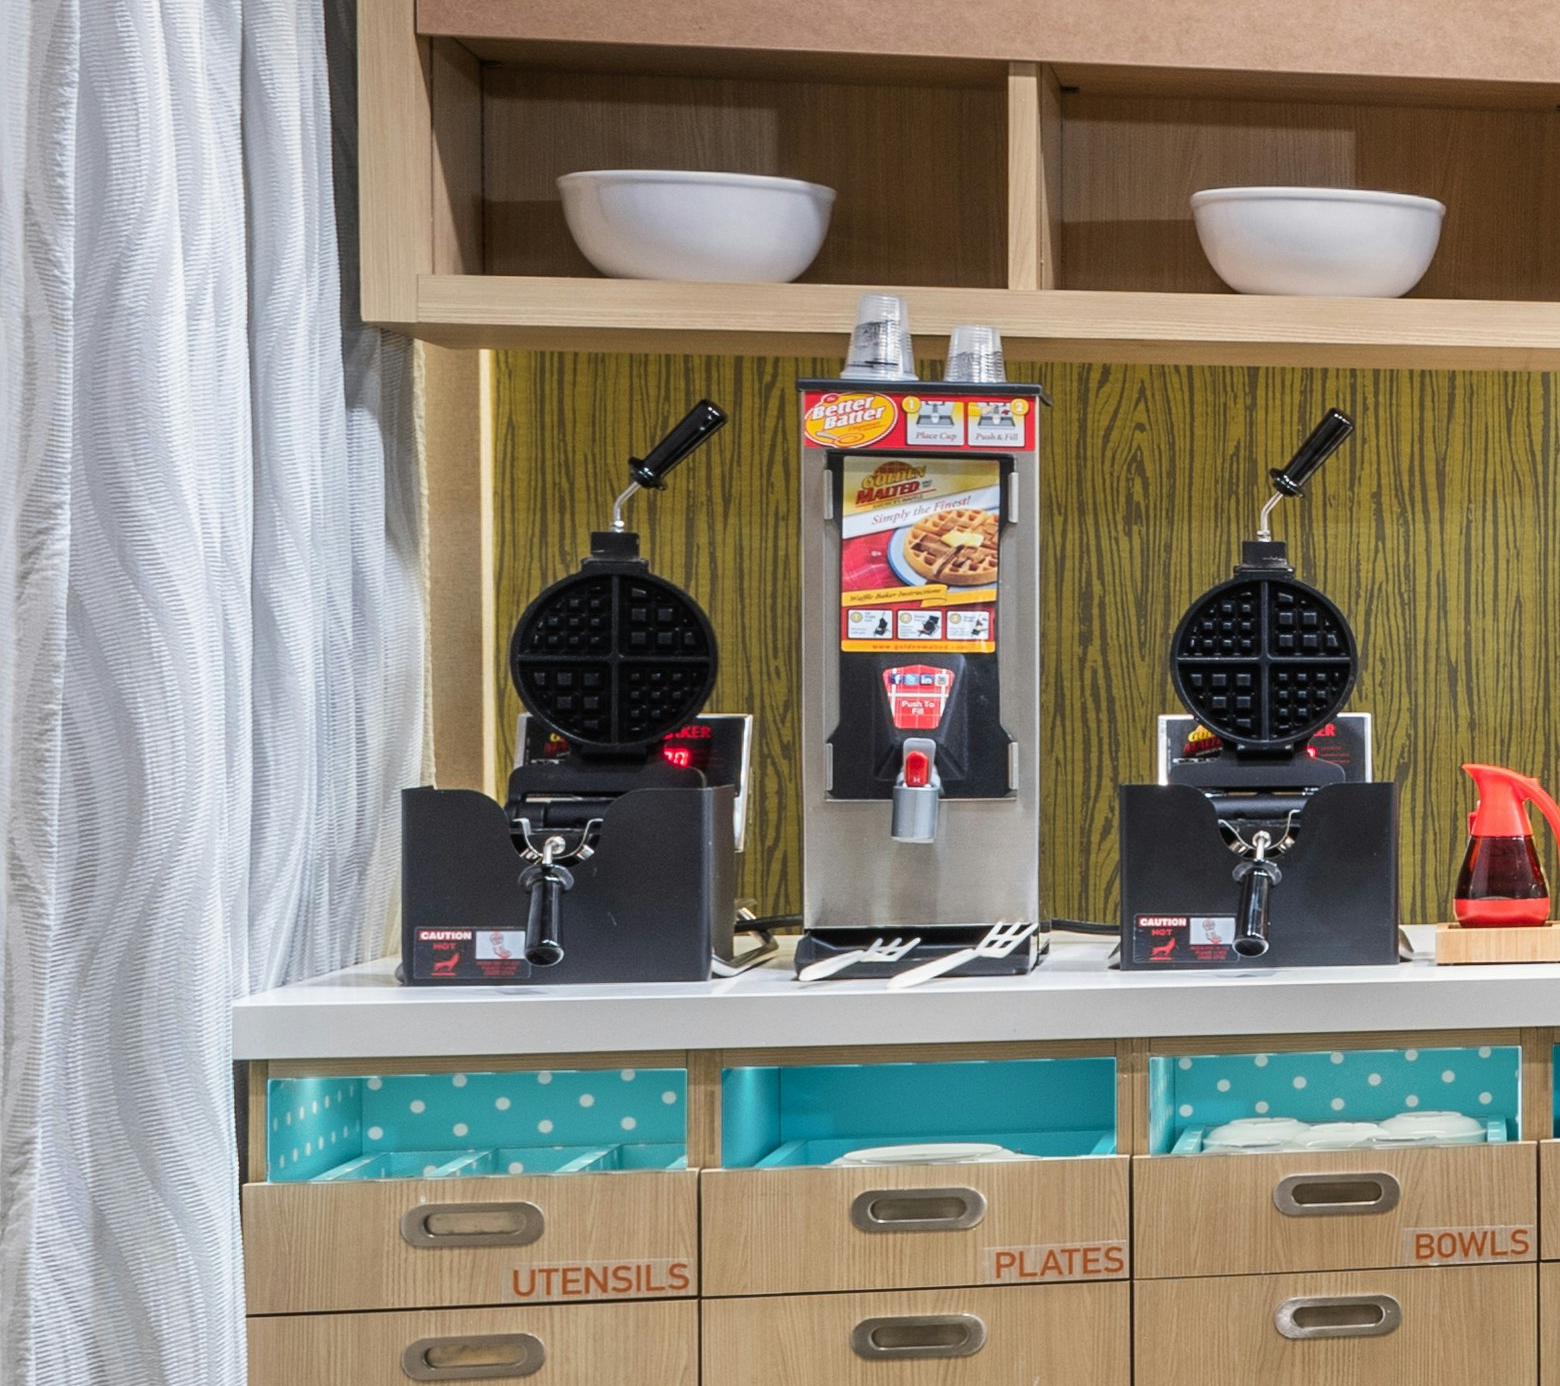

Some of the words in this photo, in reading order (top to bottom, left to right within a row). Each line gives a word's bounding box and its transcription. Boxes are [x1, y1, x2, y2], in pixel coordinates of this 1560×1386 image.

[811, 397, 874, 420] Better
[824, 407, 885, 429] Batter
[915, 431, 940, 440] Place
[942, 431, 957, 442] Cup
[976, 433, 995, 441] Push
[1004, 433, 1018, 441] Fill
[861, 464, 927, 488] GOLDEN
[855, 480, 920, 504] MALTED
[872, 508, 910, 525] Simply
[913, 505, 930, 516] the
[933, 495, 971, 512] Finest!
[901, 700, 922, 708] Push
[924, 700, 935, 708] To
[1140, 918, 1187, 926] CAUTION
[1151, 928, 1174, 936] HOT
[420, 931, 472, 940] CAUTION
[1414, 1229, 1530, 1261] BOWLS
[995, 1246, 1124, 1278] PLATES
[512, 1263, 689, 1297] UTENSILS
